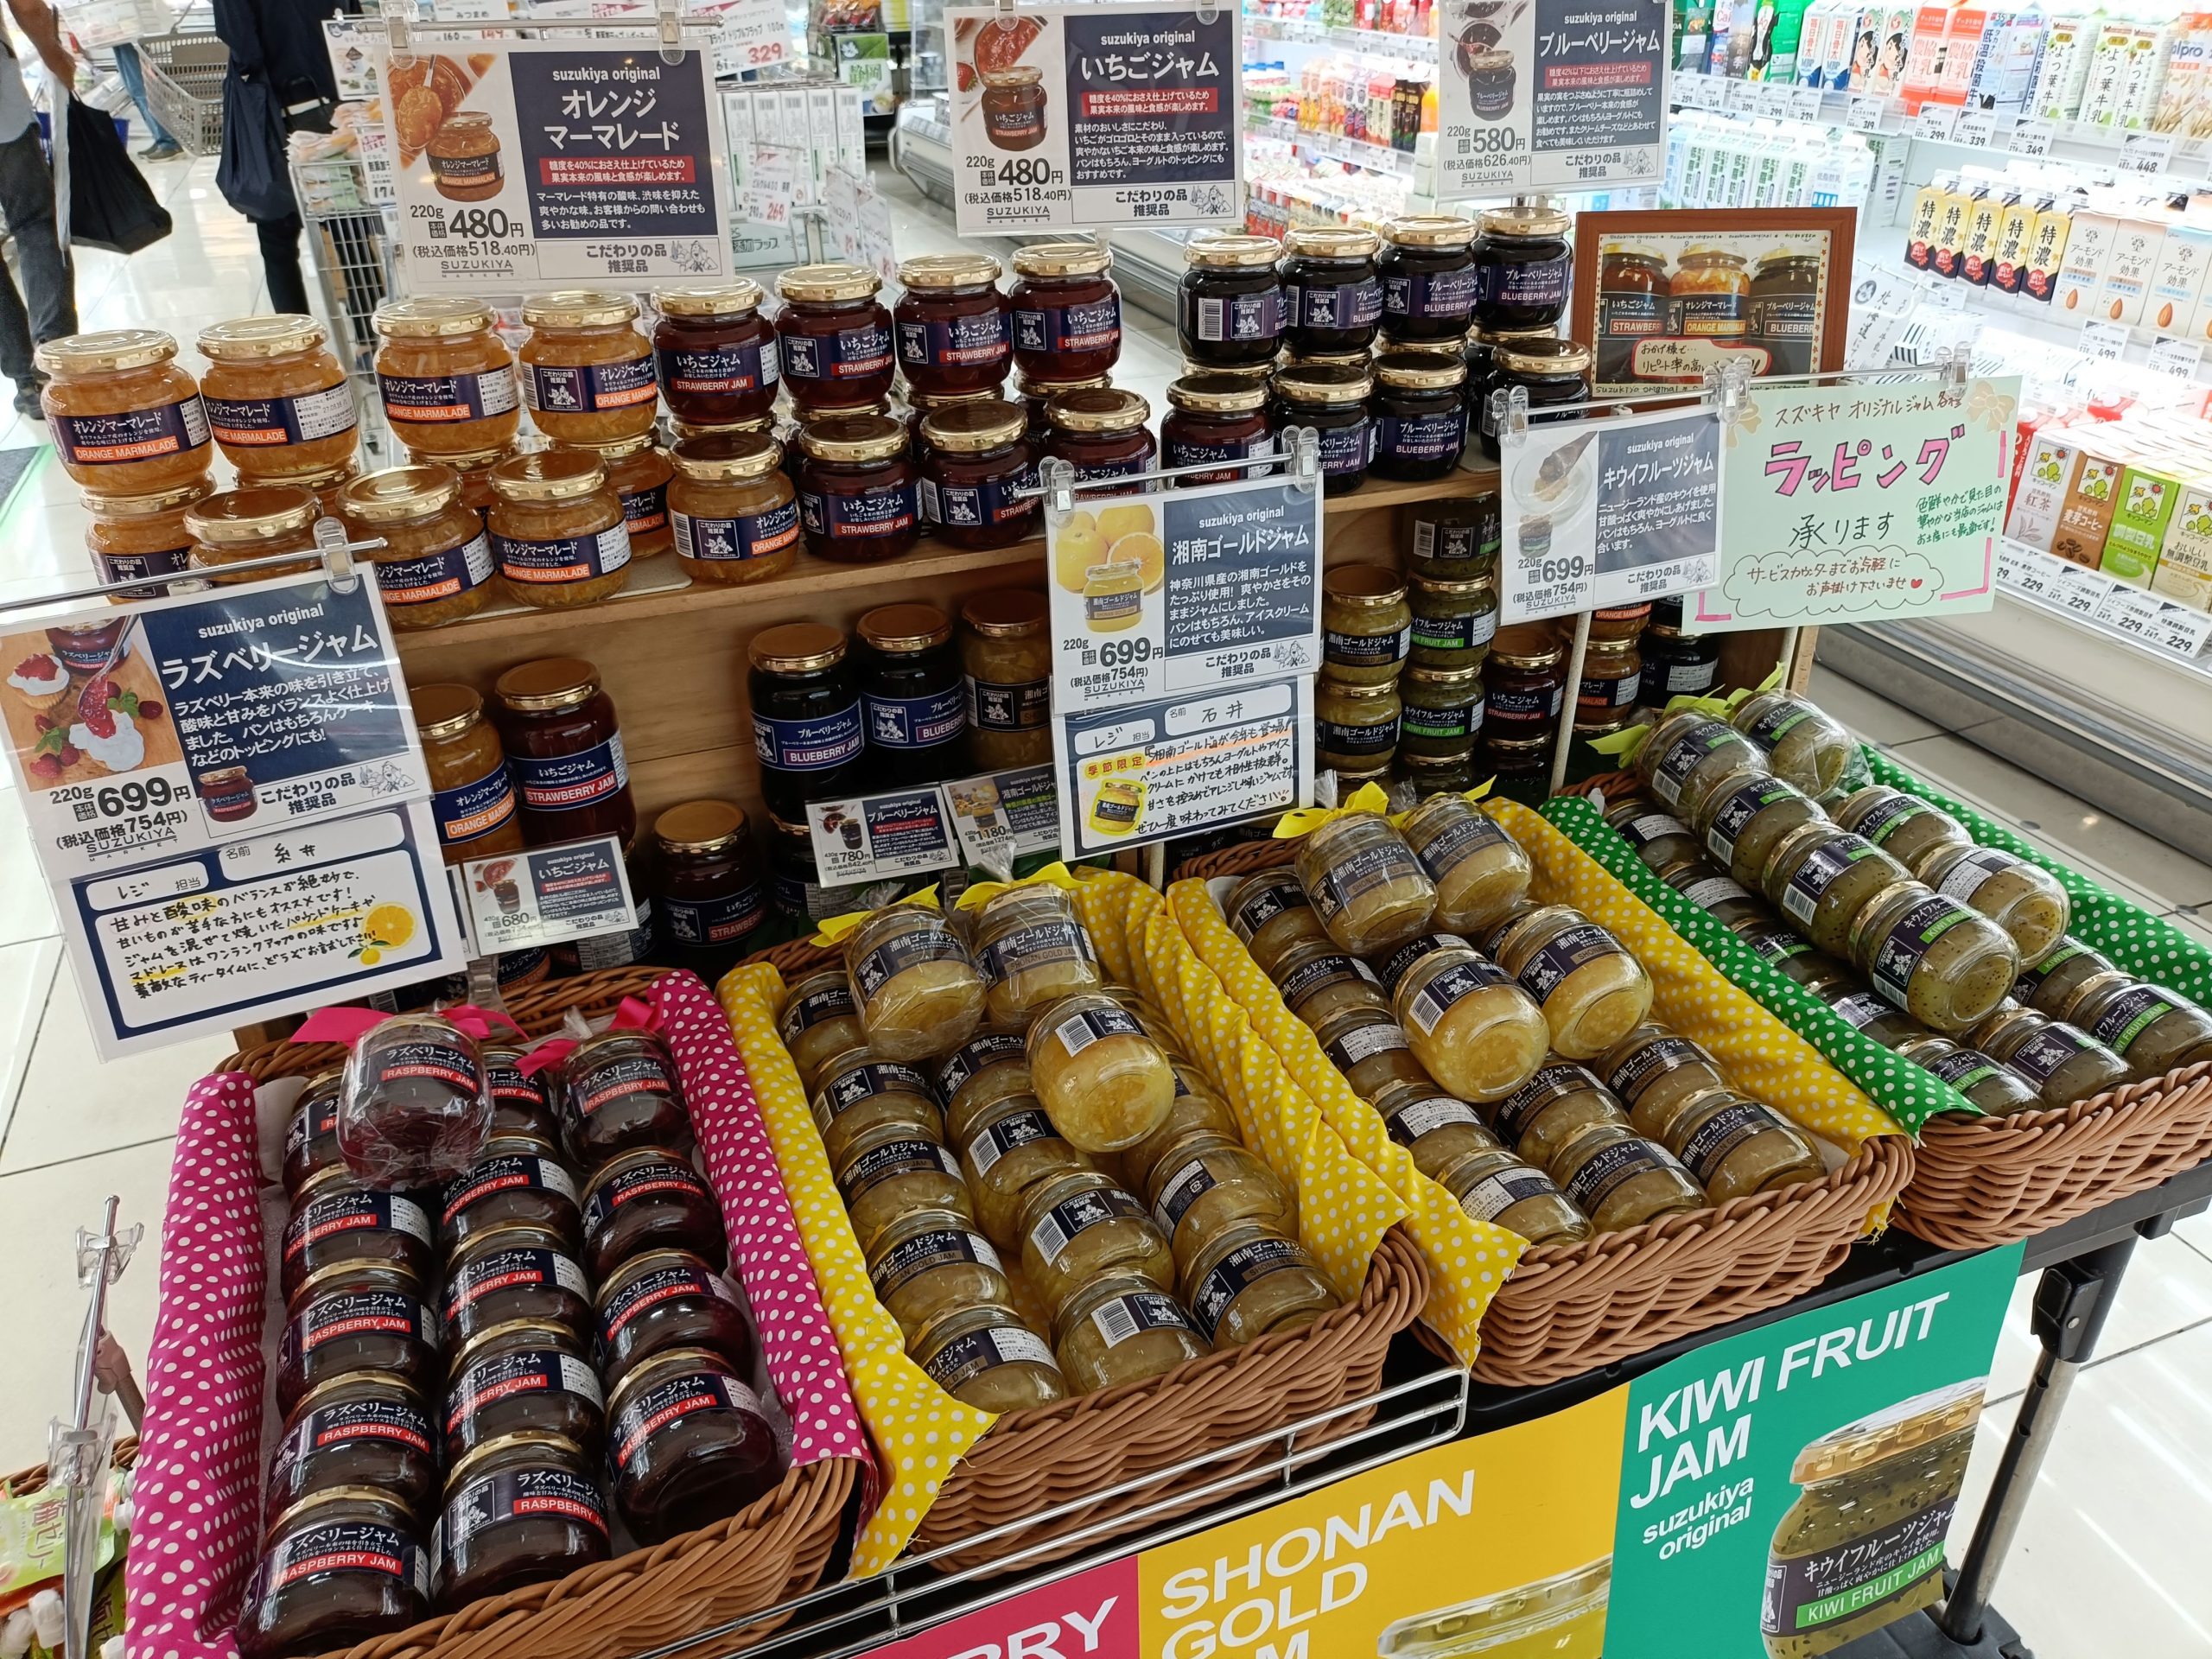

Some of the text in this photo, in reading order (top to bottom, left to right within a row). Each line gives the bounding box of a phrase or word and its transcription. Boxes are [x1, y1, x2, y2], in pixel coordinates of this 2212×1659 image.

[1565, 10, 1637, 24] suzukiya original
[1101, 30, 1195, 48] suzukiya original
[1540, 29, 1661, 57] ブルーベリージャム
[748, 43, 781, 64] 329
[553, 67, 660, 84] suzukiya original
[1082, 52, 1219, 82] いちごジャム
[562, 89, 657, 119] オレンジ
[544, 121, 679, 151] マーマレード
[1447, 126, 1471, 138] 220g
[966, 156, 995, 168] 220g
[1566, 152, 1621, 166] こだわりの品
[1462, 170, 1512, 181] SUZUKIYA
[1116, 189, 1187, 203] こだわりの品
[410, 204, 444, 220] 220g
[987, 206, 1050, 216] SUZUKIYA
[1134, 204, 1169, 216] 推奨品
[1916, 200, 1936, 239] 特濃
[1942, 207, 1961, 246] 特濃
[1971, 213, 1993, 253] 特濃
[2002, 219, 2024, 260] 特濃
[587, 244, 667, 258] こだわりの品
[2034, 225, 2056, 267] 特濃
[442, 260, 512, 270] SUZUKIYA
[607, 259, 648, 273] 推奨品
[1506, 269, 1562, 281] ブルーベリージャム
[1502, 292, 1548, 301] BLUEBERRY
[1612, 300, 1656, 310] いちごジャム
[1067, 308, 1116, 325] いちごジャム
[949, 321, 1002, 337] いちごジャム
[840, 330, 890, 351] いちごジャム
[1065, 333, 1109, 347] STRAWBERRY
[677, 353, 741, 368] いちごジャム
[947, 346, 994, 361] STRAWBERRY
[385, 379, 457, 394] オレンジマーマレード
[677, 378, 747, 391] STRAWBERRY JAM
[421, 407, 469, 418] MARMALADE
[73, 412, 162, 435] オレンジマーマレード
[1400, 420, 1459, 433] ブルーベリージャム
[238, 431, 286, 443] MARMALADE
[1627, 433, 1694, 454] suzukiya original
[76, 440, 177, 461] ORANGE MARMALADE
[1396, 443, 1444, 454] BLUEBERRY
[1765, 423, 1965, 497] ラッピング
[1604, 452, 1713, 490] キウイフルーツジャム
[843, 494, 904, 512] いちごジャム
[1199, 505, 1284, 529] suzukiya original
[842, 521, 893, 534] STRAWBERRY
[1789, 512, 1895, 549] 承ります
[503, 541, 577, 556] オレンジマーマレード
[1172, 524, 1309, 565] 湘南ゴールドジャム
[1518, 558, 1541, 569] 220g
[504, 566, 588, 580] ORANGE MARMALADE
[1628, 565, 1681, 584] こだわりの品
[1641, 580, 1667, 593] 推奨品
[2021, 577, 2044, 593] 229
[1526, 594, 1576, 608] SUZUKIYA
[2068, 596, 2091, 612] 229
[199, 604, 324, 639] suzukiya original
[2118, 617, 2142, 632] 229
[1064, 639, 1089, 651] 220g
[1329, 635, 1394, 645] 湘南ゴールドジャム
[2166, 635, 2193, 652] 229
[162, 624, 378, 690] ラズベリージャム
[1205, 647, 1270, 668] こだわりの品
[1222, 663, 1254, 677] 推奨品
[1084, 679, 1144, 694] SUZUKIYA
[1170, 708, 1185, 718] 名前
[798, 719, 851, 740] ブルーベリージャム
[1095, 727, 1122, 748] レジ
[1133, 731, 1149, 742] 担当
[790, 743, 845, 762] BLUEBERRY
[538, 760, 594, 778] いちごジャム
[1088, 756, 1142, 776] 季節限定
[49, 785, 94, 805] 220g
[261, 772, 356, 804] こだわりの品
[527, 784, 595, 802] STRAWBERRY
[288, 794, 337, 816] 推奨品
[868, 805, 938, 823] ブルーベリージャム
[450, 817, 487, 835] ORANGE
[86, 827, 175, 854] SUZUKIYA
[226, 845, 251, 859] 名前
[539, 858, 609, 880] いちごジャム
[118, 881, 150, 899] レジ
[175, 877, 201, 891] 担当
[1928, 921, 1948, 938] KIWI
[386, 1045, 475, 1072] ラズベリージャム
[386, 1067, 454, 1085] RASPBERRY
[617, 1185, 680, 1207] RASPBERRY
[1637, 1291, 1949, 1452] KIWI FRUIT
[324, 1408, 429, 1432] ラズベリージャム
[324, 1425, 402, 1441] RASPBERRY
[1630, 1414, 1752, 1510] JAM
[1643, 1477, 1755, 1544] suzukiya
[1659, 1497, 1752, 1560] original
[1160, 1469, 1478, 1621] SHONAN
[1804, 1505, 1959, 1583] キウイフルーツジャム
[1808, 1550, 1940, 1623] KIWI FRUIT JAM
[1161, 1561, 1369, 1659] GOLD
